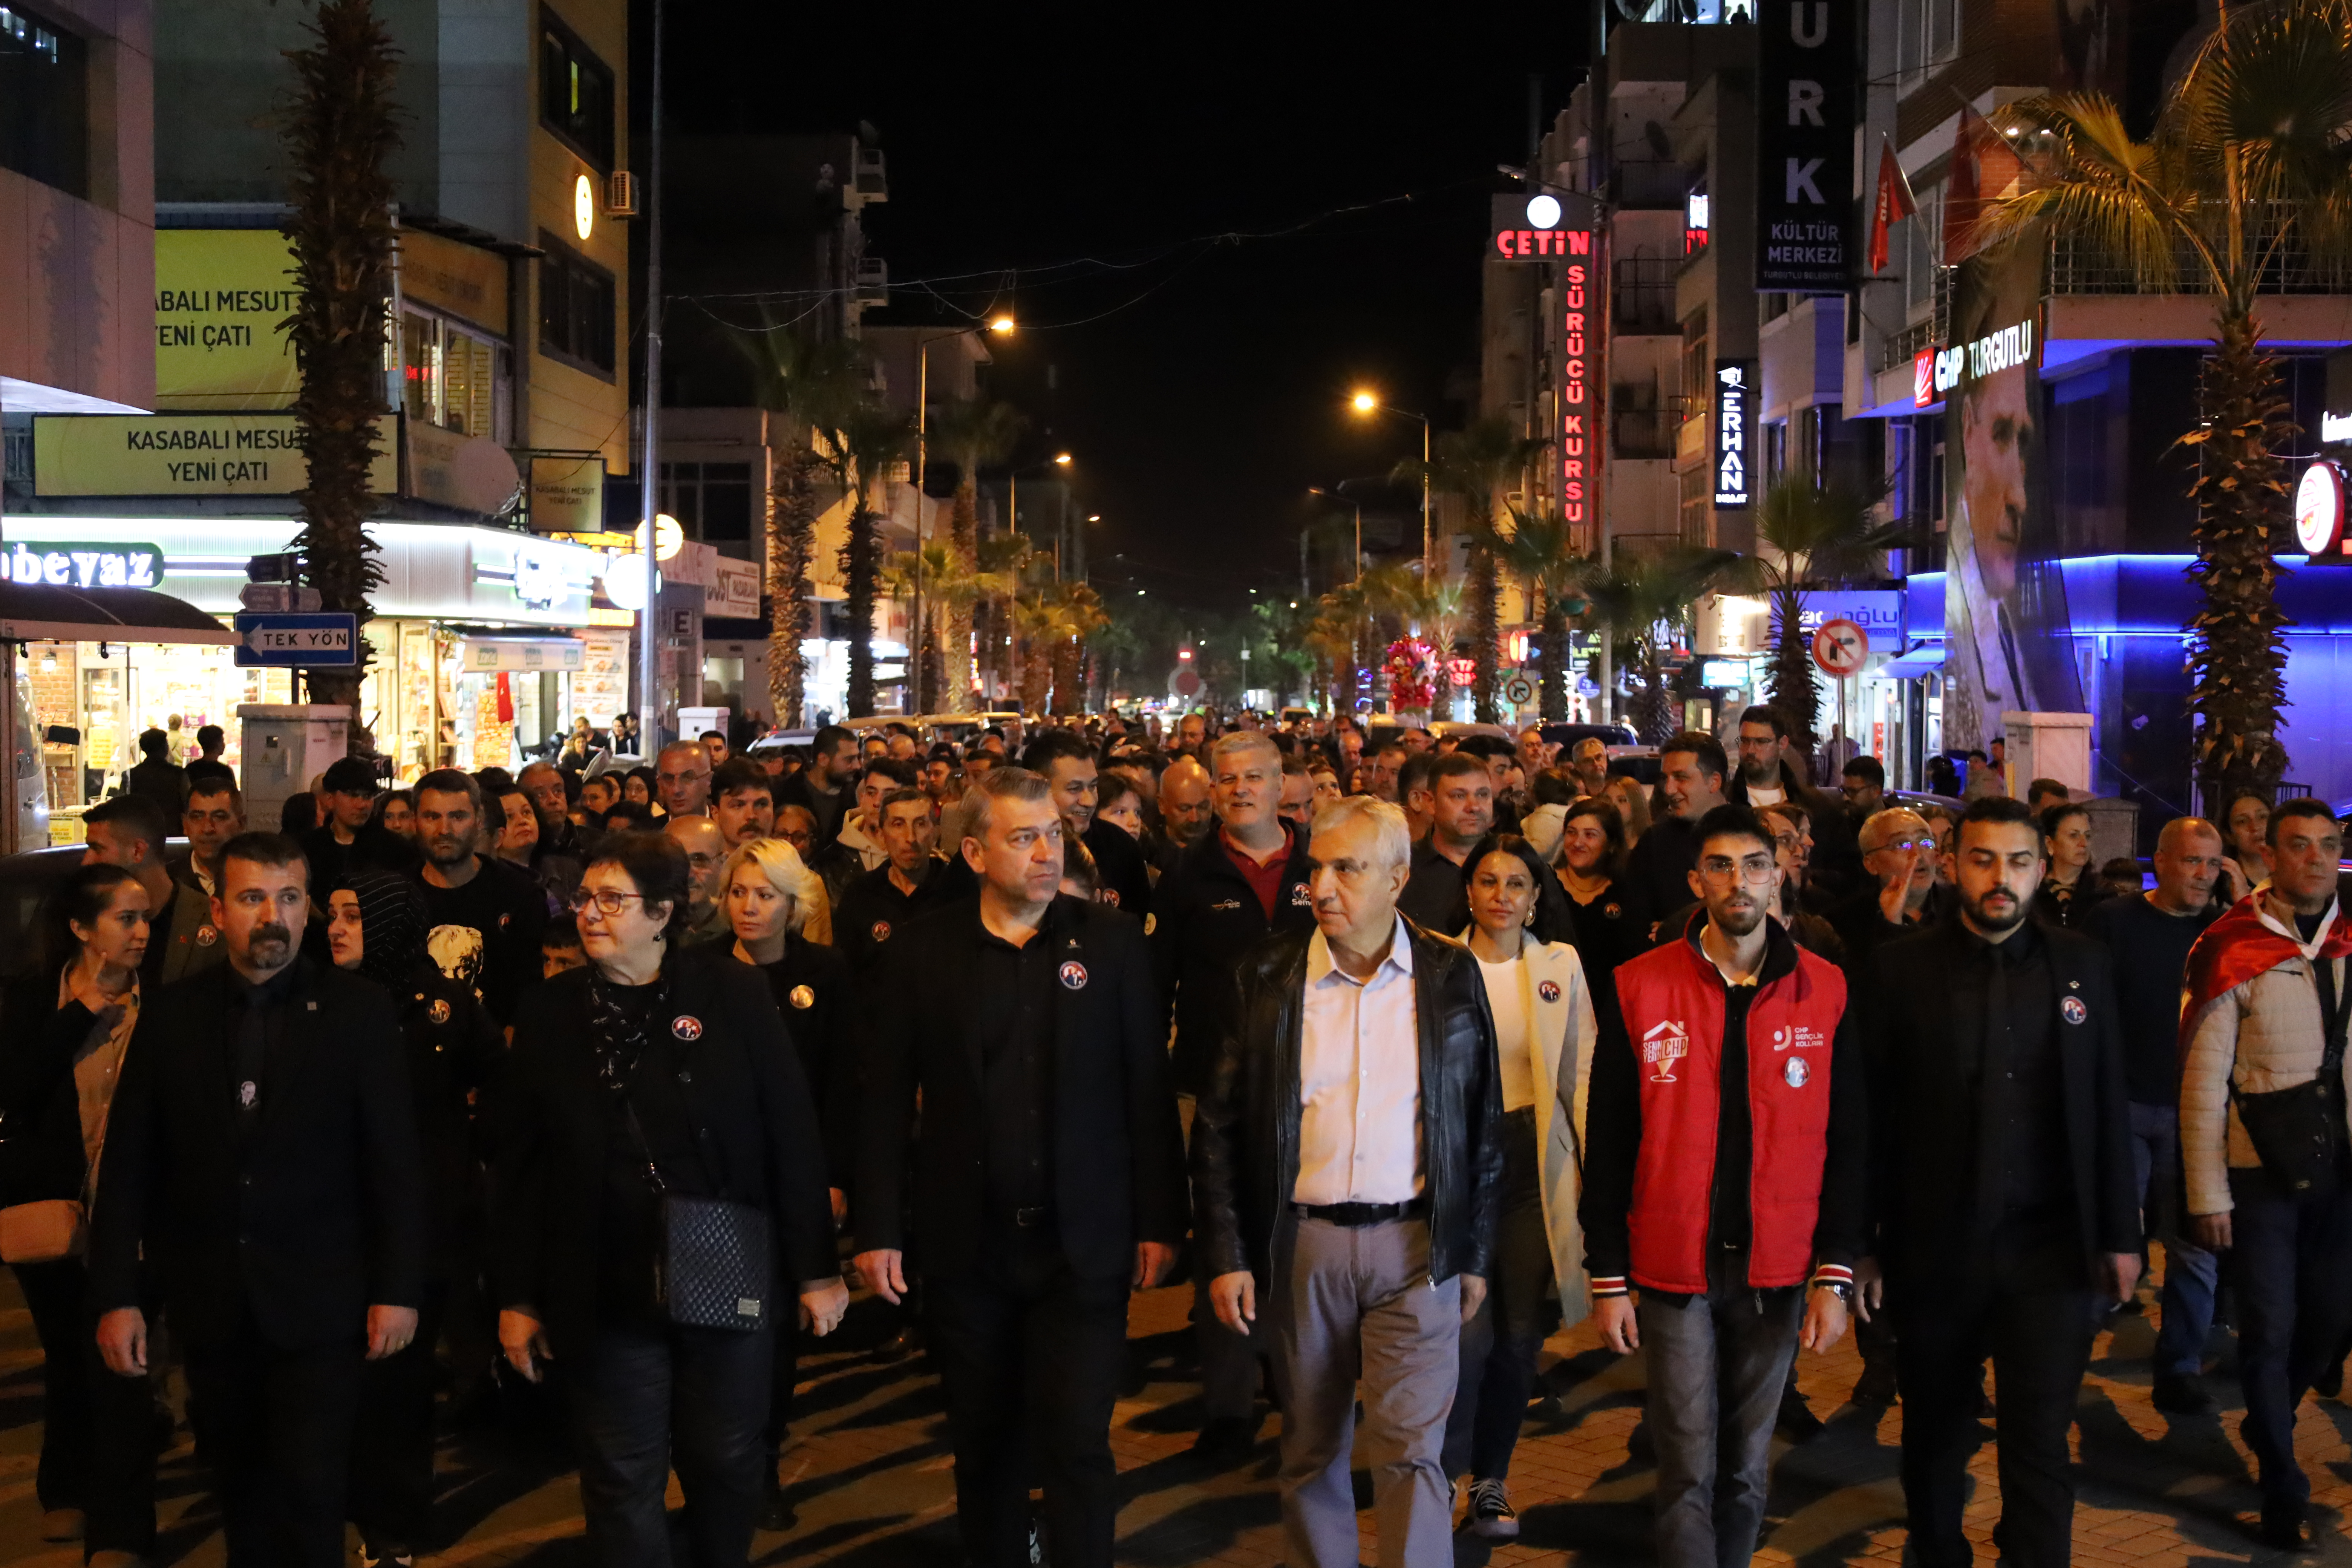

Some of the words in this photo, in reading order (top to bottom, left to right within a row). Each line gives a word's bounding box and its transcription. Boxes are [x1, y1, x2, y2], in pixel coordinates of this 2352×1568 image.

[1772, 220, 1839, 240] KÜLTÜR
[1768, 243, 1842, 263] MERKEZİ
[217, 291, 294, 311] MESUT
[202, 325, 250, 352] ÇATI
[1566, 265, 1585, 404] SÜRÜCÜ
[1935, 345, 1964, 392] CHP
[1968, 319, 2032, 380] TURGUTLU
[128, 430, 229, 450] KASABALI
[1720, 392, 1743, 490] ERHAN
[167, 457, 216, 481] YENİ
[223, 461, 268, 486] ÇATI
[1564, 415, 1583, 522] KURSU
[264, 633, 298, 646] TEK
[309, 630, 347, 646] YÖN
[1795, 1032, 1824, 1040] GENÇLİK
[1664, 1038, 1686, 1056] CHP
